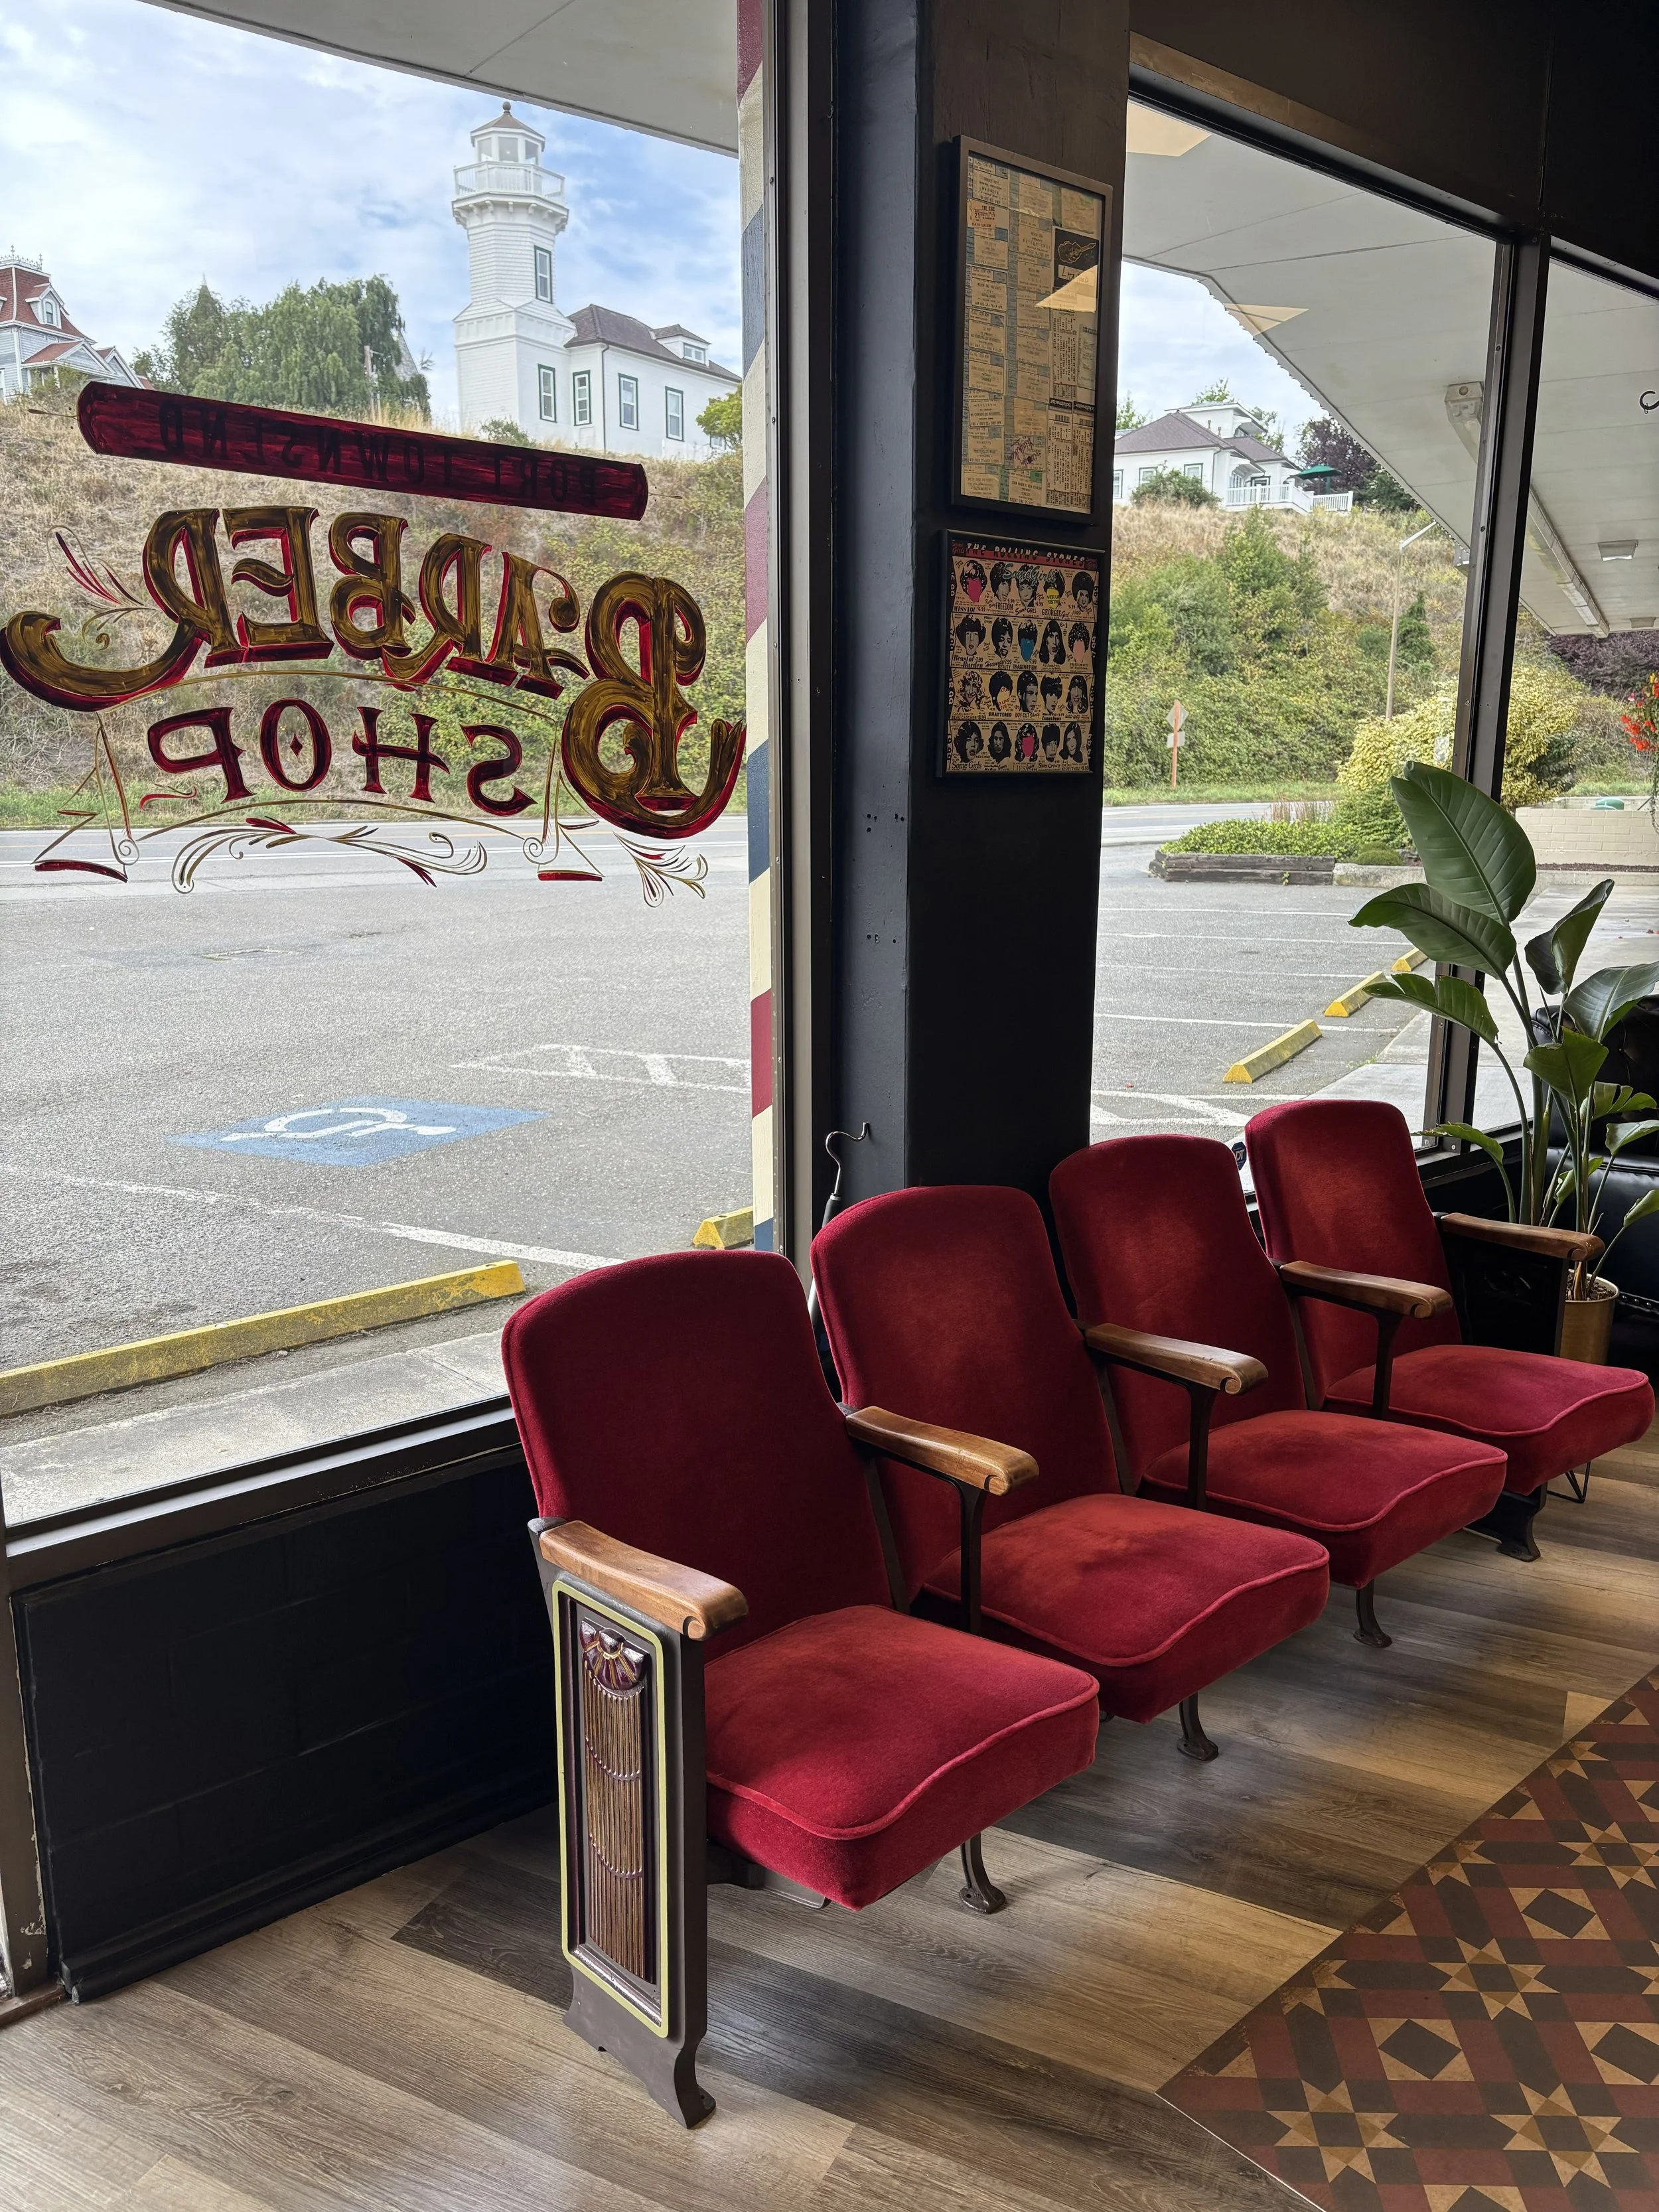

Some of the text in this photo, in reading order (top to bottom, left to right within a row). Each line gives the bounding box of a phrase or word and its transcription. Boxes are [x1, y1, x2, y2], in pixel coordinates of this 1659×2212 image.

[967, 542, 987, 555] THE
[994, 546, 1039, 561] ROLLING
[1046, 552, 1086, 567] STONES
[1003, 563, 1056, 587] Some Girls
[995, 601, 1013, 611] FREEDOM
